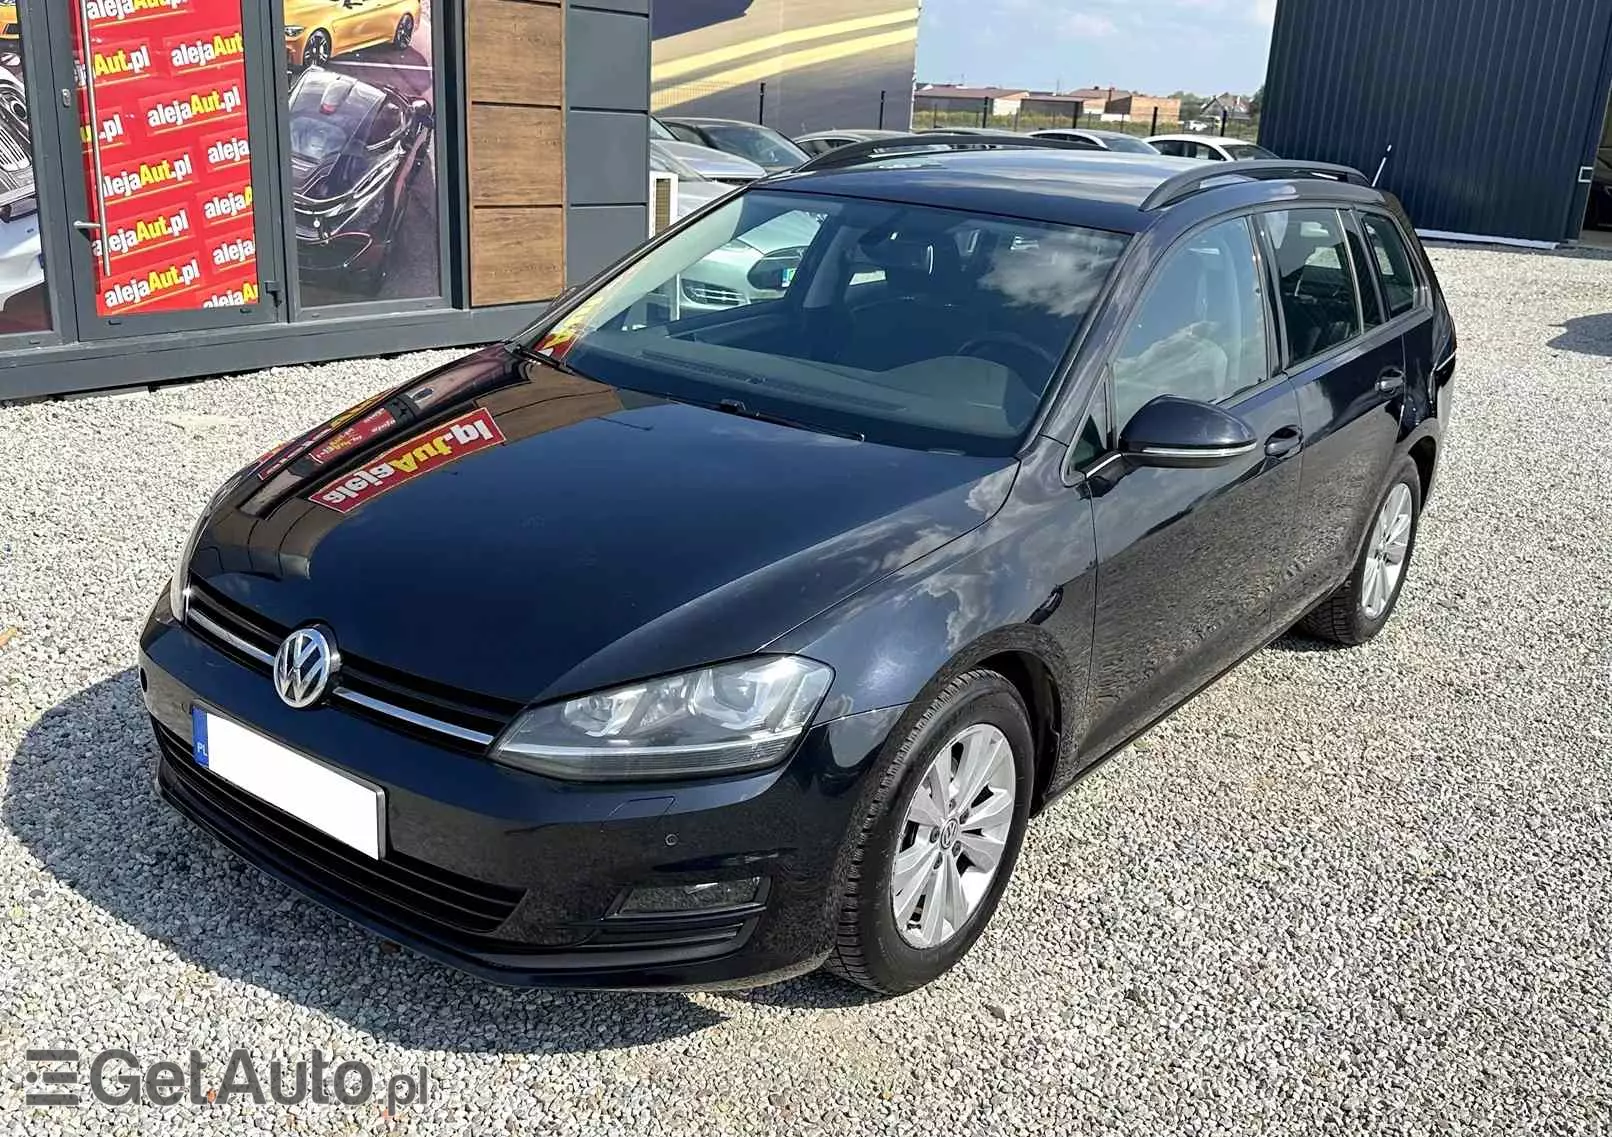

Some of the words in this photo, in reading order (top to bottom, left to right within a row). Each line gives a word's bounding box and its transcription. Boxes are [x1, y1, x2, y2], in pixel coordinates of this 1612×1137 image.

[87, 0, 188, 20] alejaAu.
[147, 85, 241, 127] alejaAut.pl
[207, 137, 250, 165] aleja
[92, 209, 189, 257] aejaAut.pl
[104, 259, 200, 308] alejaAut.pl
[196, 741, 208, 757] PL
